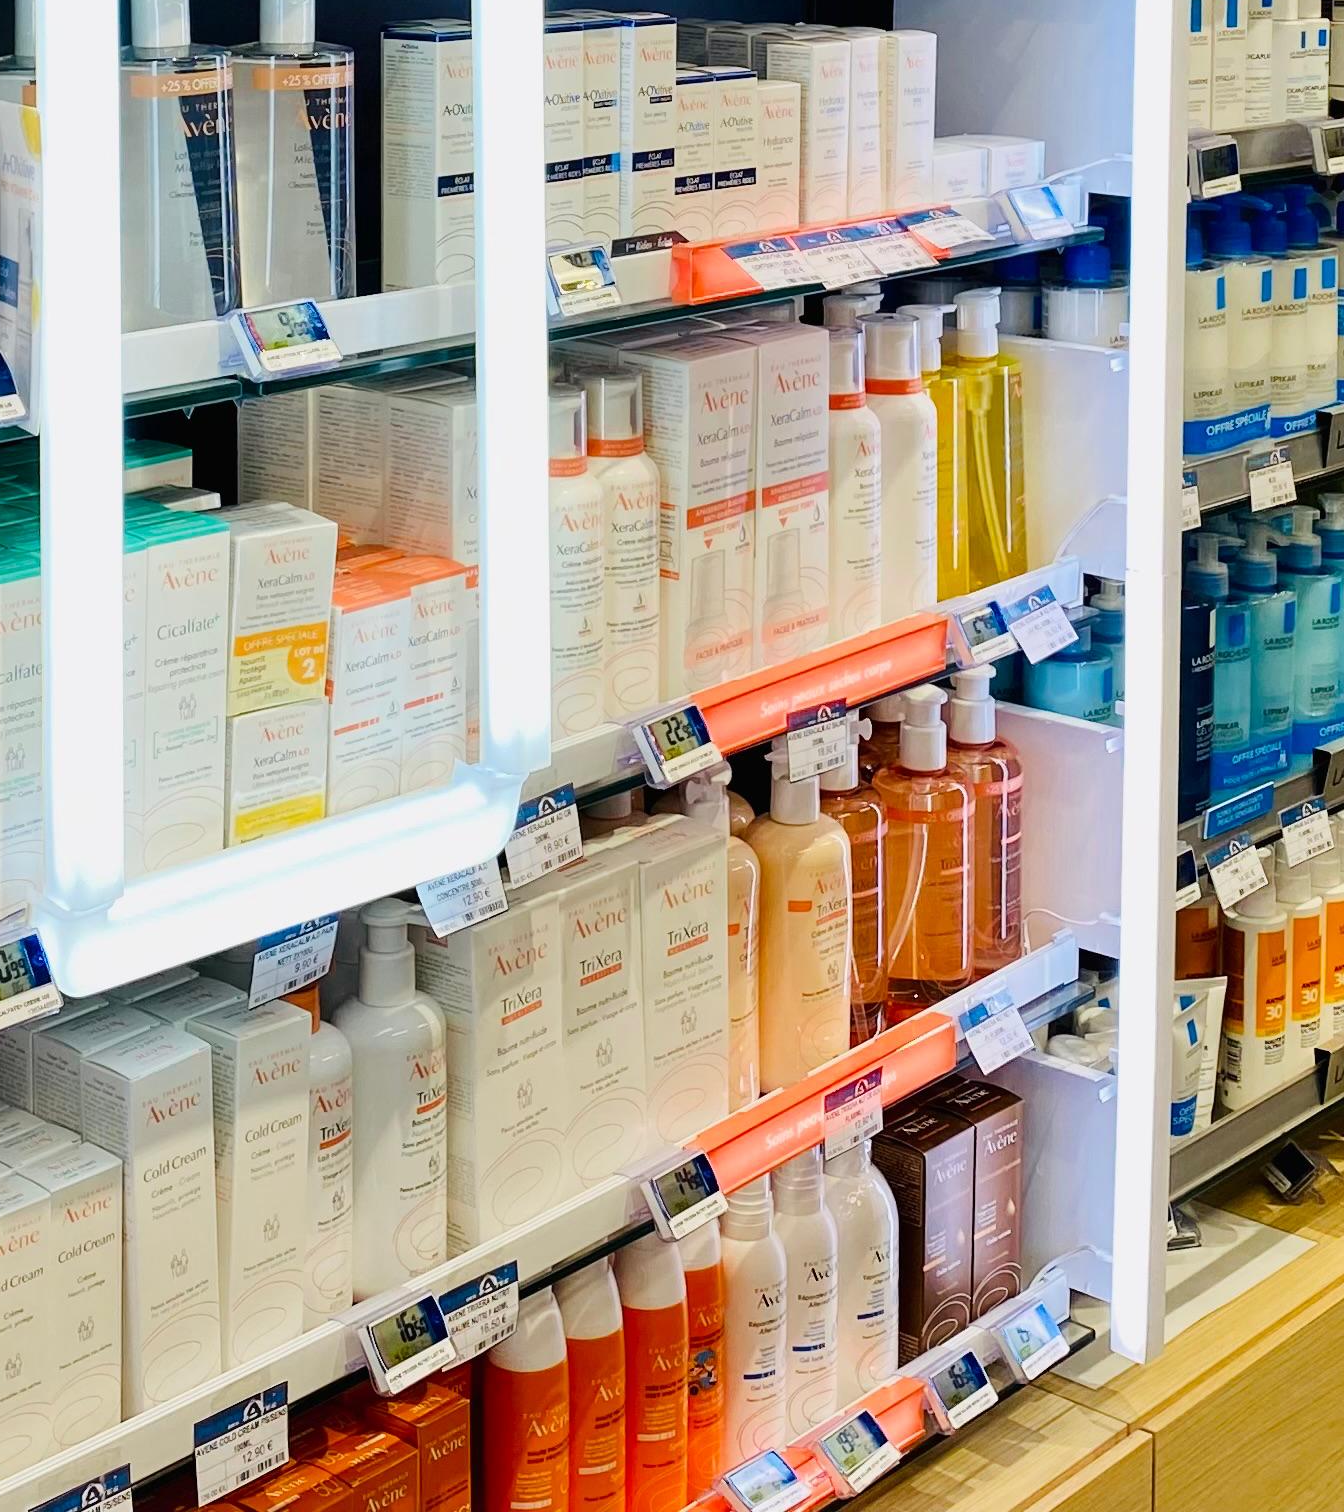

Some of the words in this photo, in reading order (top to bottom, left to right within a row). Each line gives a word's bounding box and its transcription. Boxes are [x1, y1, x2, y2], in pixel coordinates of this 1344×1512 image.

[256, 573, 302, 590] XeraCalm
[302, 659, 315, 677] 2
[143, 1160, 172, 1184] Cold
[174, 1145, 207, 1171] Cream
